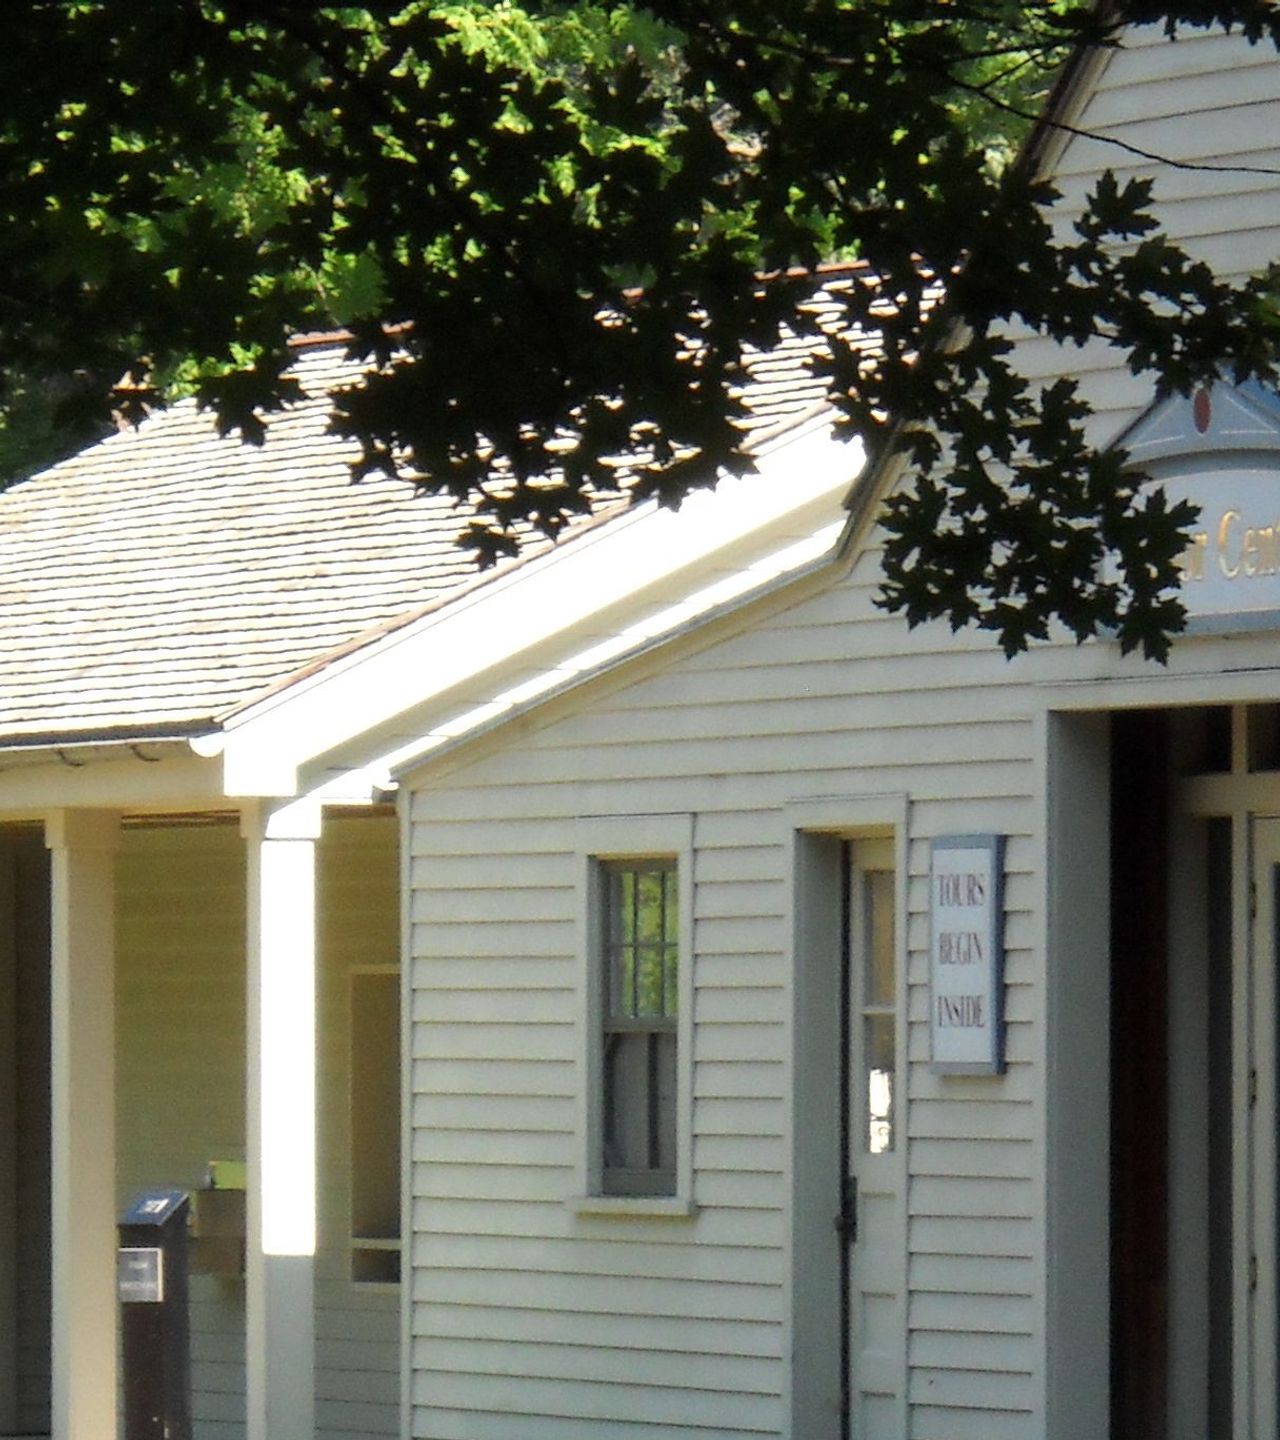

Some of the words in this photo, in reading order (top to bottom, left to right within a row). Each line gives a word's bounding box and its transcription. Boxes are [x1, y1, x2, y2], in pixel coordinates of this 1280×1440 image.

[937, 873, 985, 907] TOURS
[939, 931, 984, 965] BEGIN
[937, 995, 985, 1029] INSIDE
